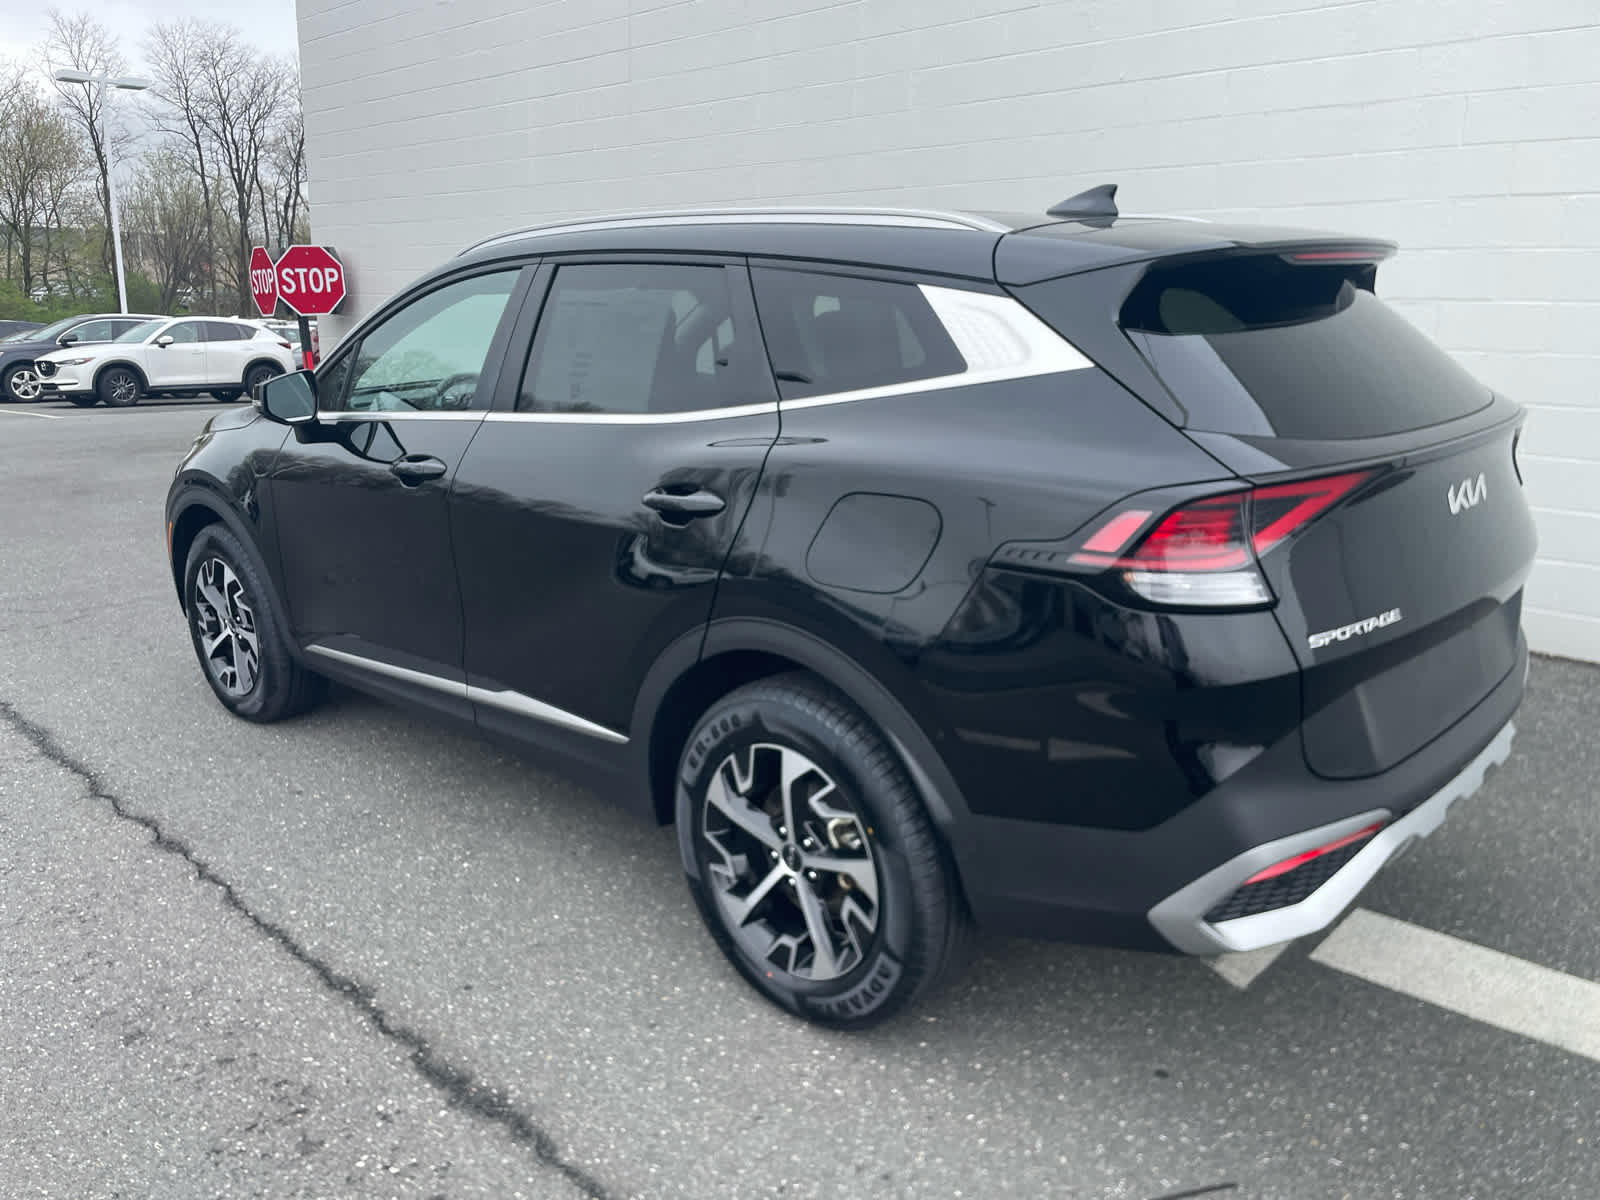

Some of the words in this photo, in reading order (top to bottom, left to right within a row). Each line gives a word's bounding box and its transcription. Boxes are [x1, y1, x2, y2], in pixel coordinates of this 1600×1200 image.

[252, 269, 274, 294] STOP
[281, 267, 339, 294] STOP
[1308, 607, 1403, 649] SPORTAGE
